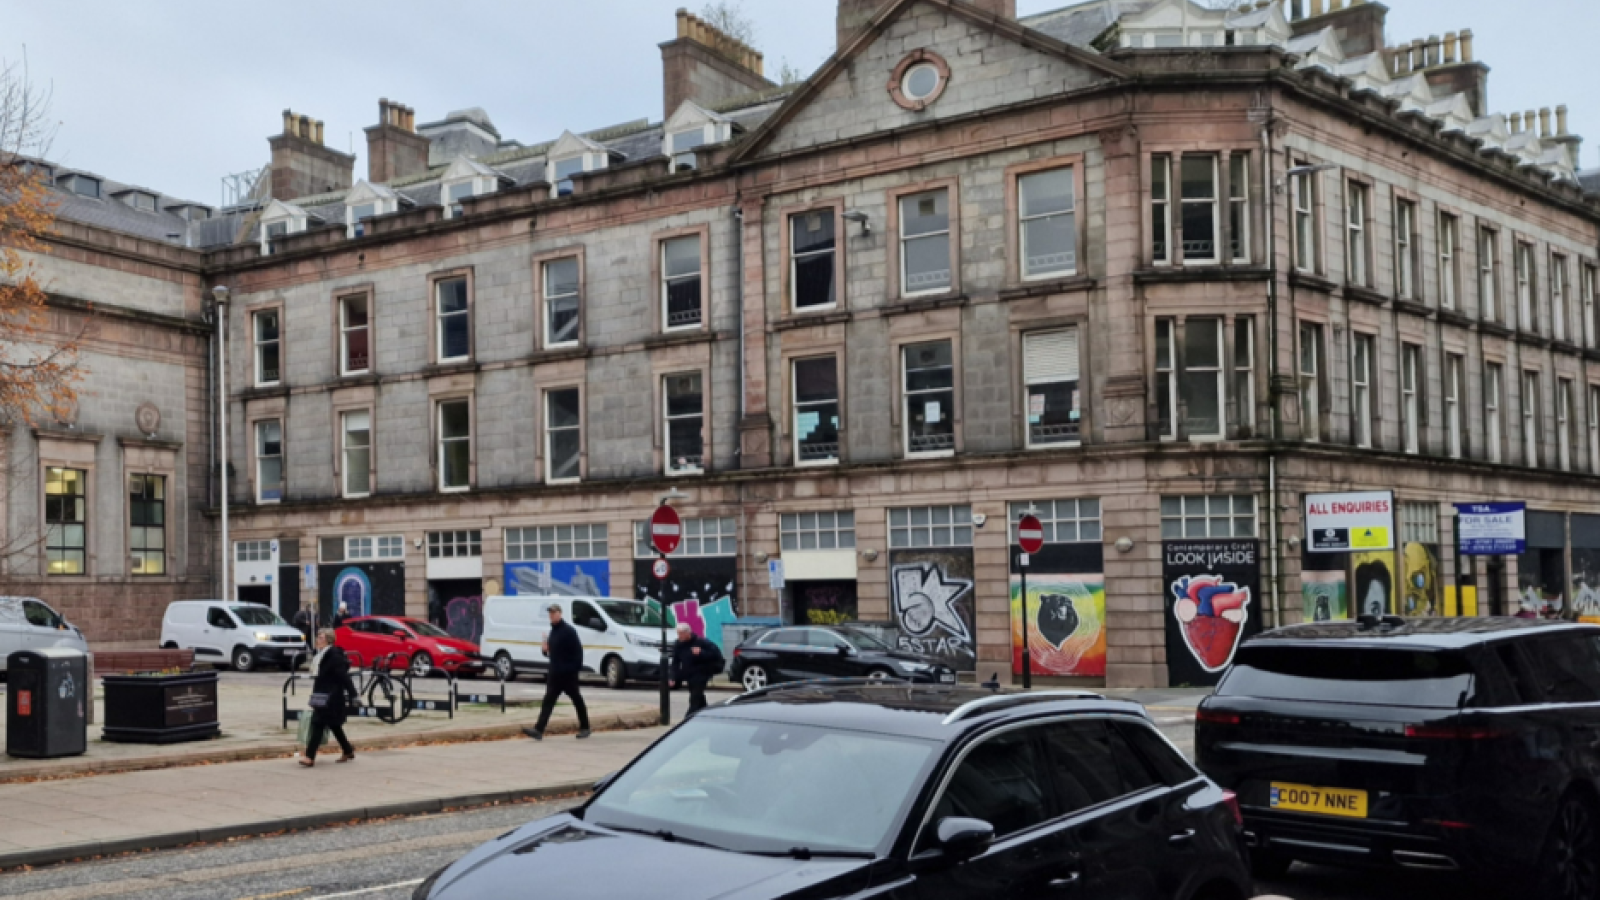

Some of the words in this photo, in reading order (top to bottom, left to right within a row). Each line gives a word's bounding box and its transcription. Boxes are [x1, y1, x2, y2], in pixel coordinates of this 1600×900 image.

[1309, 502, 1329, 515] ALL
[1331, 500, 1389, 515] ENQUIRIES
[1484, 515, 1513, 525] SALE
[1167, 544, 1229, 553] Contemporary
[1231, 542, 1254, 551] Craft
[1167, 553, 1206, 565] LOOK
[899, 636, 968, 656] 5STAR
[1325, 794, 1358, 810] NNE
